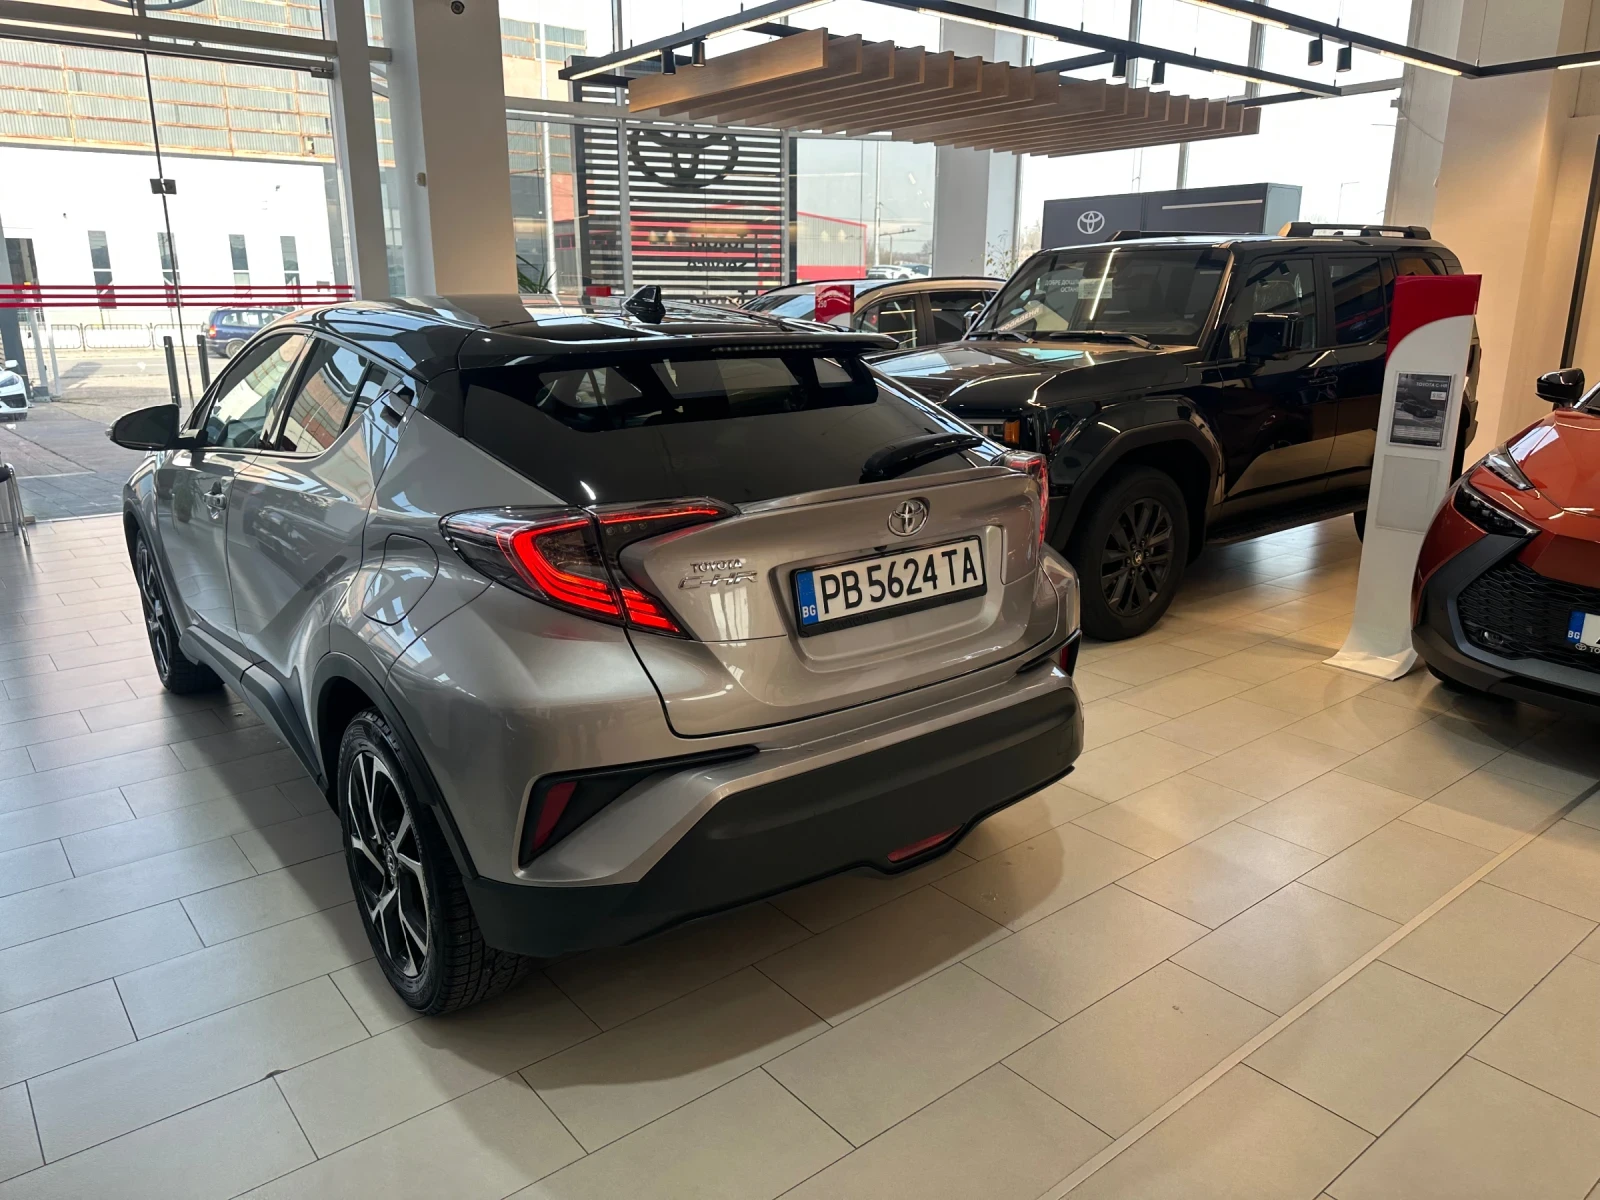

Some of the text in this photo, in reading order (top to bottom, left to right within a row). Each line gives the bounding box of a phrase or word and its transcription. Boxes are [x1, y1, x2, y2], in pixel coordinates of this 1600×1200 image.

[690, 558, 743, 574] TOYOTA
[678, 570, 759, 590] C-HR
[820, 547, 978, 614] PB 5624 TA
[802, 605, 817, 619] BG
[1567, 630, 1580, 639] BG
